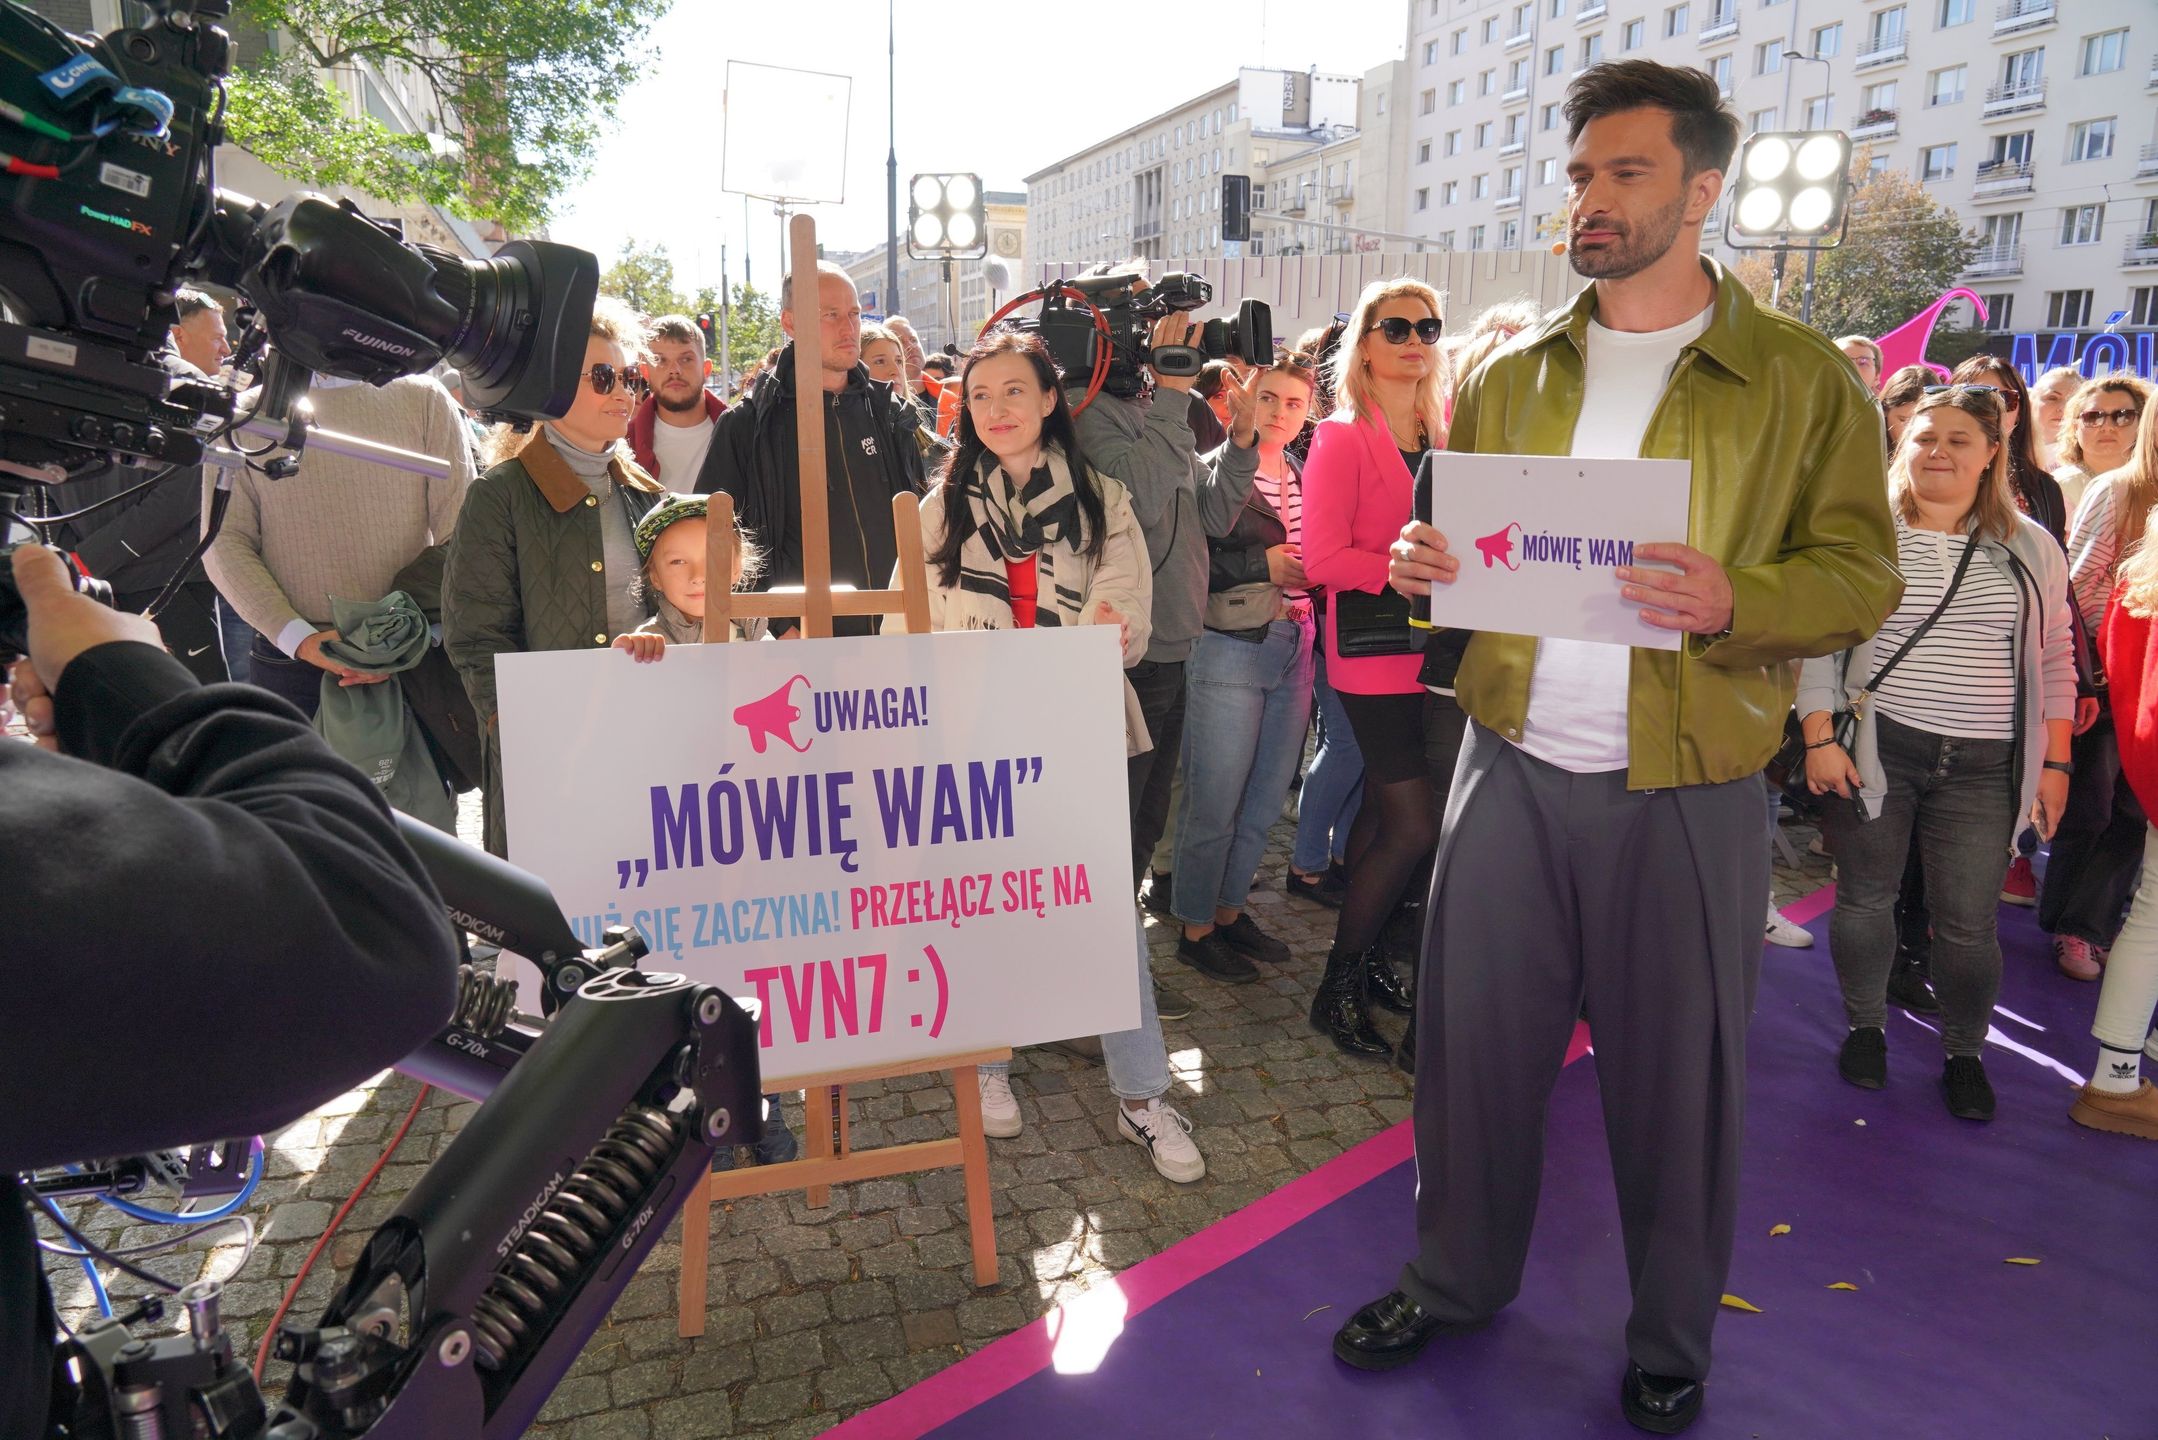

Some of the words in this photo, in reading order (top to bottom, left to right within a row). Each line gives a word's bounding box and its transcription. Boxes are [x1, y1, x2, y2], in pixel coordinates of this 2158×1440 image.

[341, 328, 416, 357] FUJINON
[1523, 530, 1582, 570] MÓWIĘ
[1588, 538, 1634, 566] WAM
[814, 686, 929, 733] UWAGA!
[617, 763, 859, 889] „MÓWIĘ
[873, 756, 1043, 849] WAM”
[633, 906, 684, 960] SIĘ
[691, 890, 841, 948] ZACZYNA!
[849, 872, 996, 930] PRZEŁĄCZ
[1001, 867, 1047, 919] SIĘ
[1053, 863, 1093, 907] NA
[743, 953, 889, 1049] TVN7
[907, 943, 951, 1039] :)
[446, 1033, 489, 1058] G-70x
[497, 1172, 564, 1257] STEADICAM
[622, 1206, 654, 1249] G-70x
